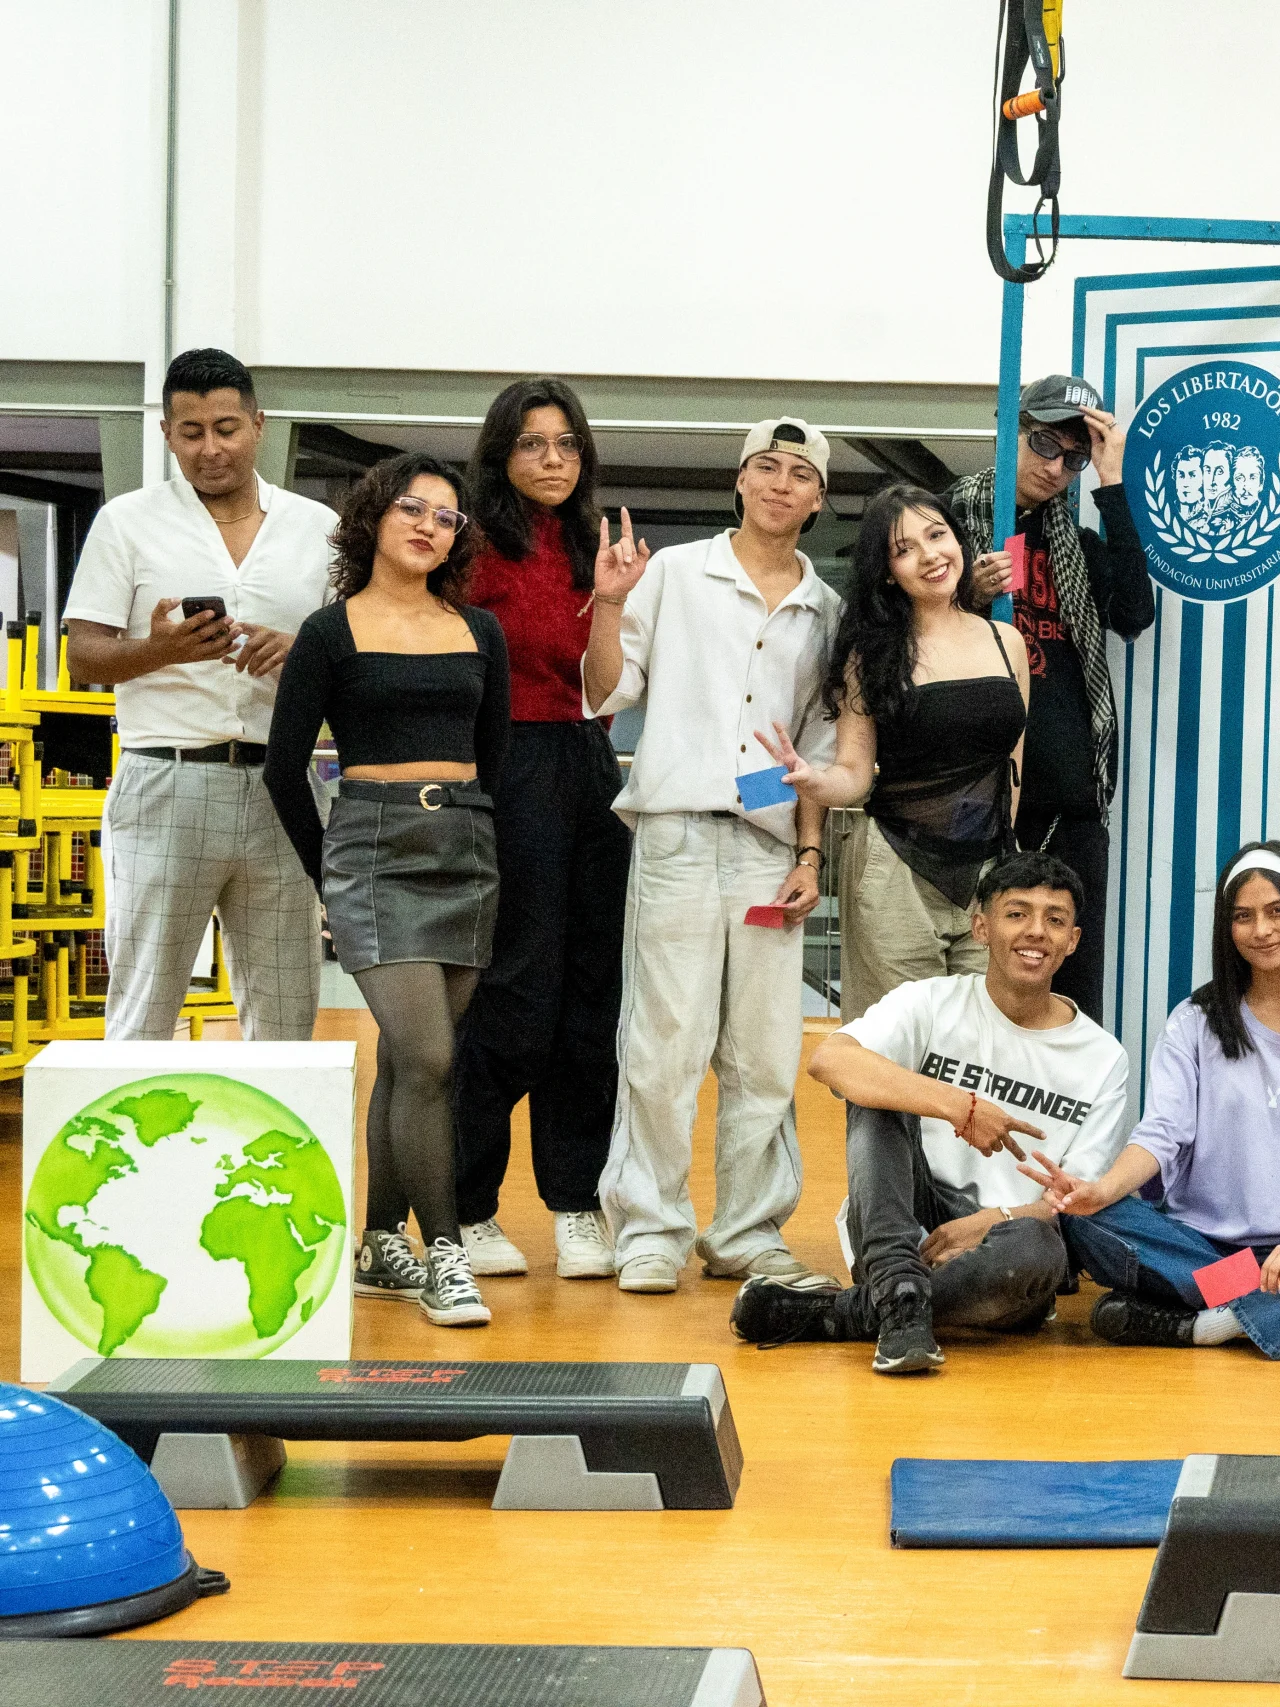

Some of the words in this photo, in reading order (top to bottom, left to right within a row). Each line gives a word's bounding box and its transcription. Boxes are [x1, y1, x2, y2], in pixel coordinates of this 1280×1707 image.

[1138, 397, 1171, 439] LOS
[1203, 411, 1241, 431] 1982
[1144, 543, 1201, 588] FUNDACIÓN
[920, 1052, 960, 1084] BE
[163, 1659, 385, 1676] STEP
